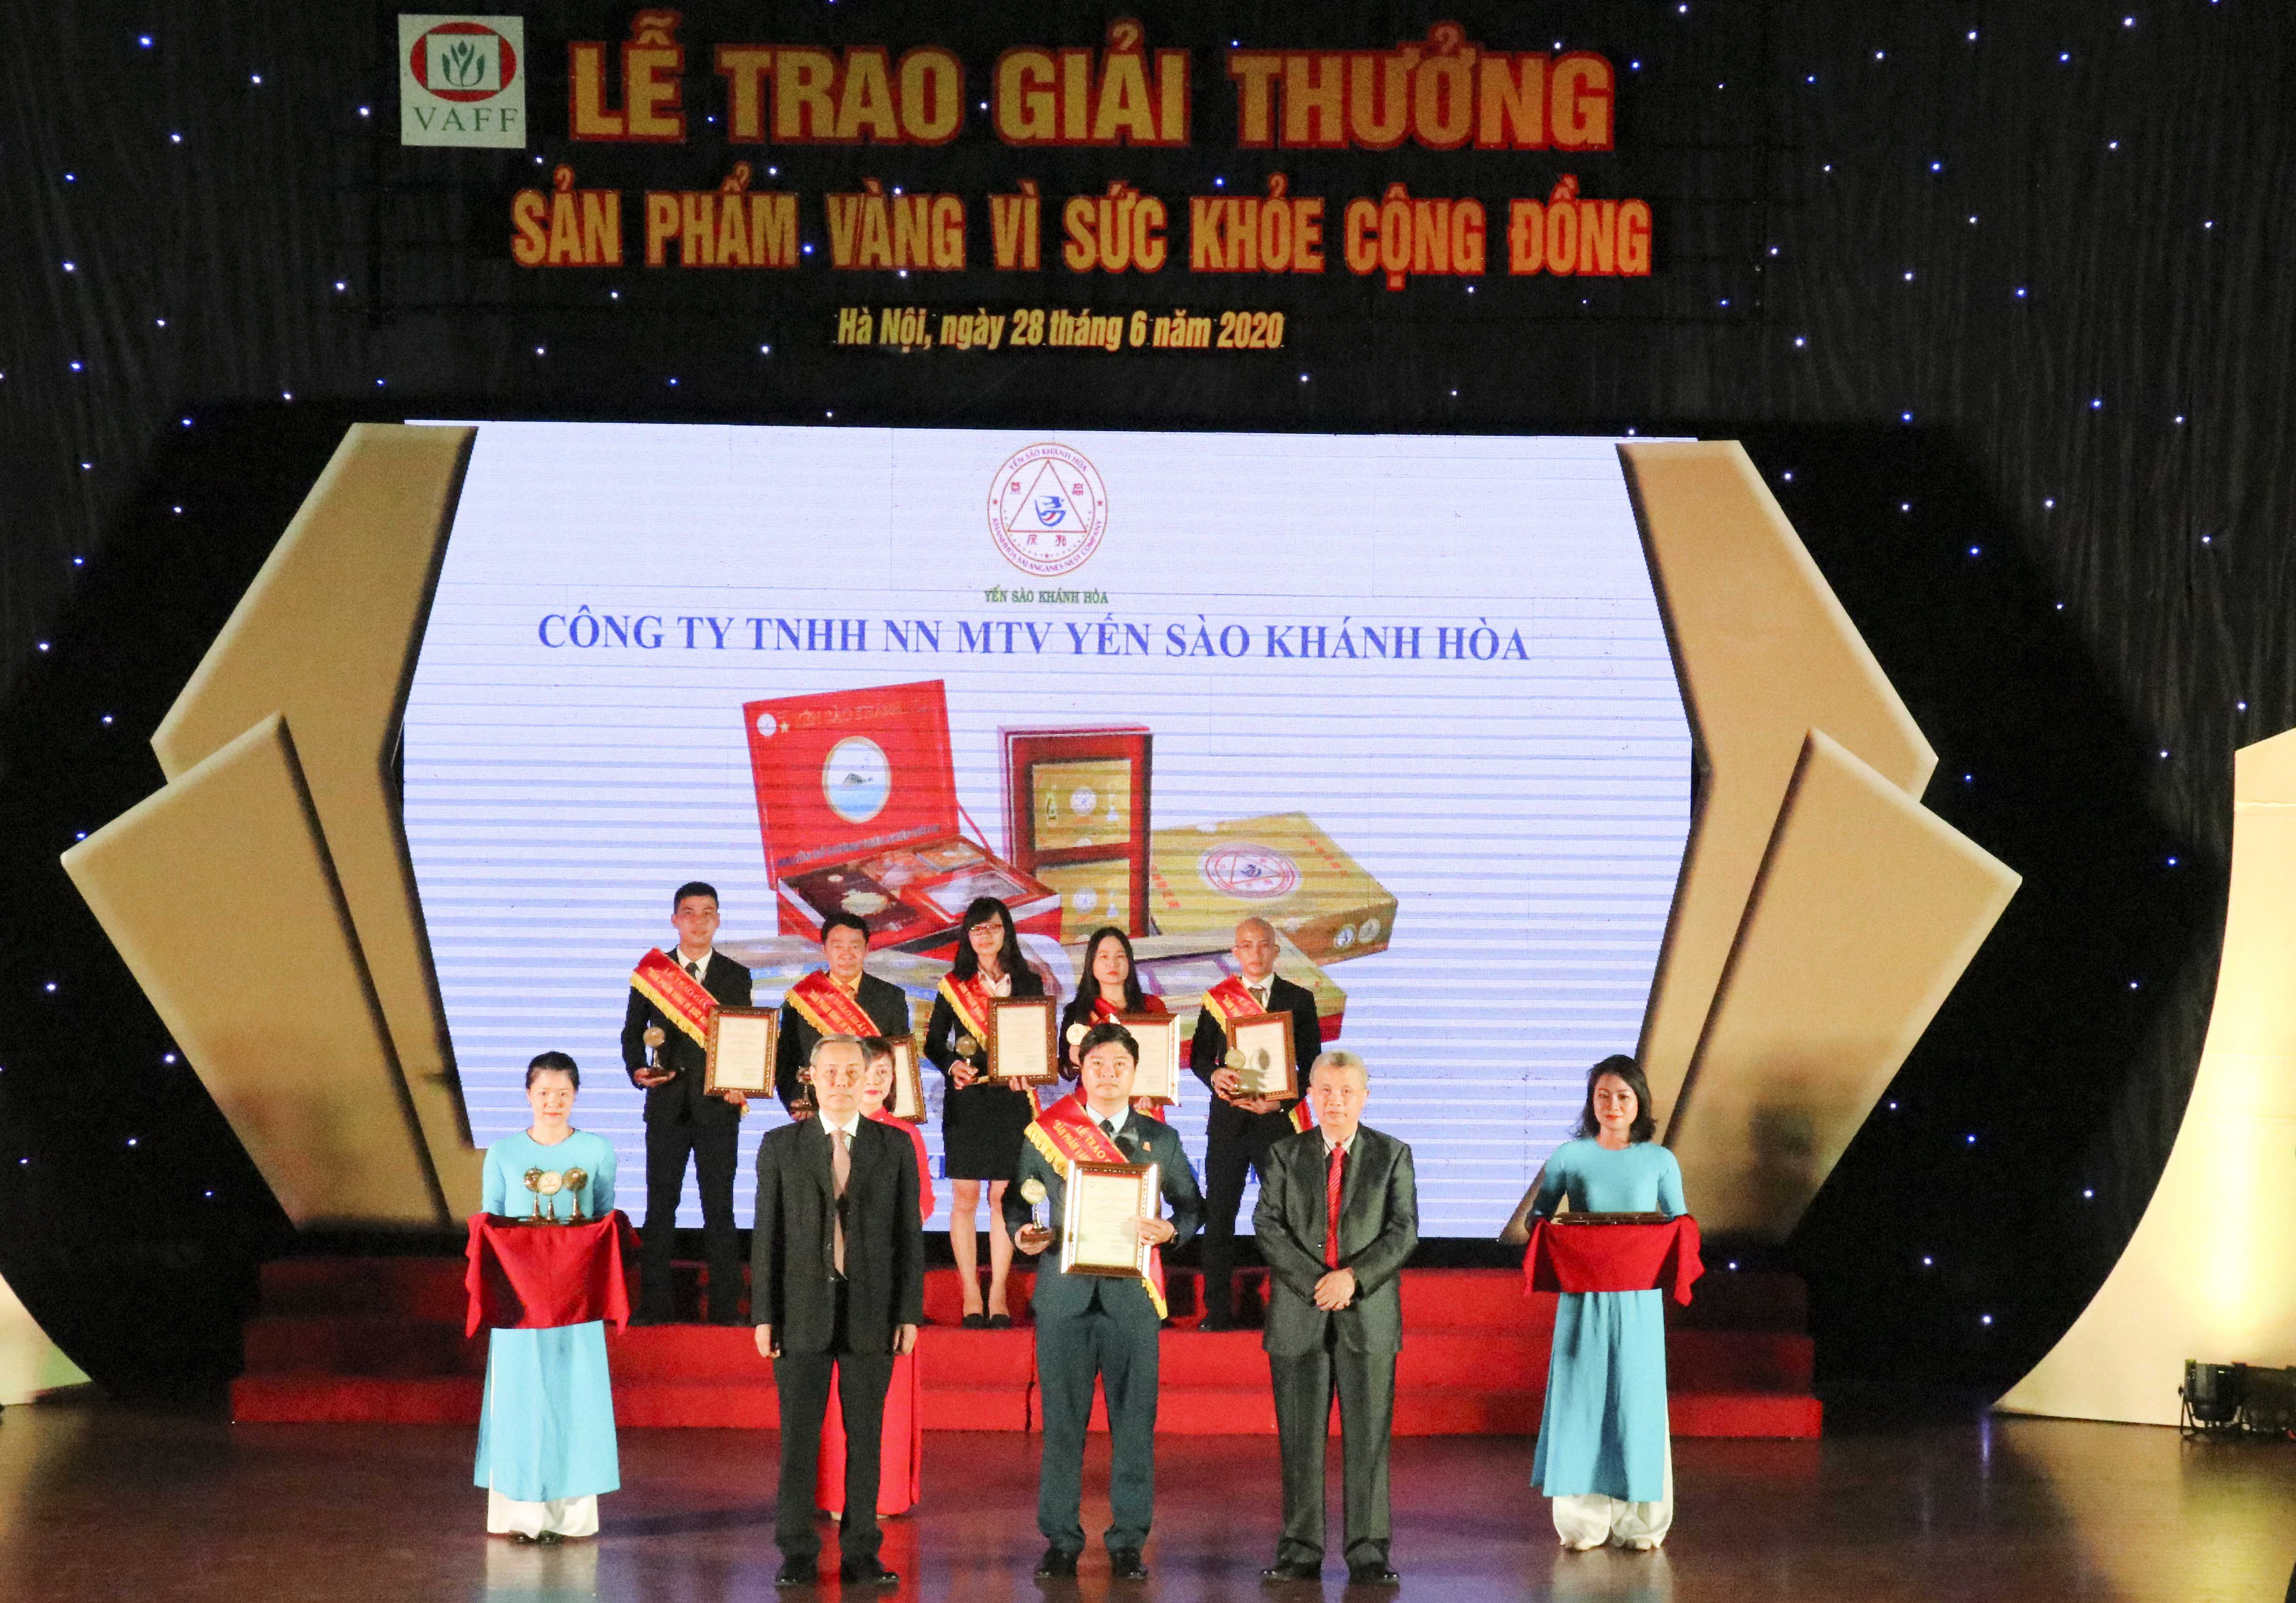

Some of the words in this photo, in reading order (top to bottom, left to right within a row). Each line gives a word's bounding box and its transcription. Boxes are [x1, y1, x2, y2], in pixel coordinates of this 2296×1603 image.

[569, 9, 685, 142] LỄ
[715, 43, 964, 145] TRAO
[992, 16, 1191, 147] GIẢI
[1226, 20, 1614, 151] THƯỞNG
[412, 105, 520, 132] VAFF
[511, 165, 621, 267] SẢN
[645, 162, 799, 268] PHẨM
[825, 177, 966, 270] VÀNG
[989, 179, 1039, 271] VÌ
[1062, 181, 1168, 273] SỨC
[1189, 172, 1325, 273] KHỎE
[1344, 182, 1486, 290] CỘNG
[1507, 174, 1652, 276] ĐỒNG
[839, 307, 871, 345] Hà
[880, 309, 933, 353] Nội,
[940, 308, 1005, 350] ngày
[1010, 309, 1044, 346] 28
[1049, 309, 1123, 352] tháng
[1129, 310, 1146, 348] 6
[1153, 310, 1211, 349] năm
[1217, 311, 1284, 349] 2020
[984, 585, 1008, 602] YẾN
[1011, 587, 1034, 603] SÀO
[1038, 587, 1079, 603] KHÁNH
[1084, 588, 1109, 604] HÒA
[539, 605, 665, 649] CÔNG
[677, 616, 735, 650] TY
[747, 618, 870, 651] TNHH
[884, 620, 942, 653] NN
[956, 621, 1053, 654] MTV
[1066, 612, 1151, 656] YẾN
[1165, 614, 1251, 658] SÀO
[1265, 616, 1423, 659] KHÁNH
[1437, 618, 1530, 660] HÒA
[1085, 1136, 1106, 1159] TRAO
